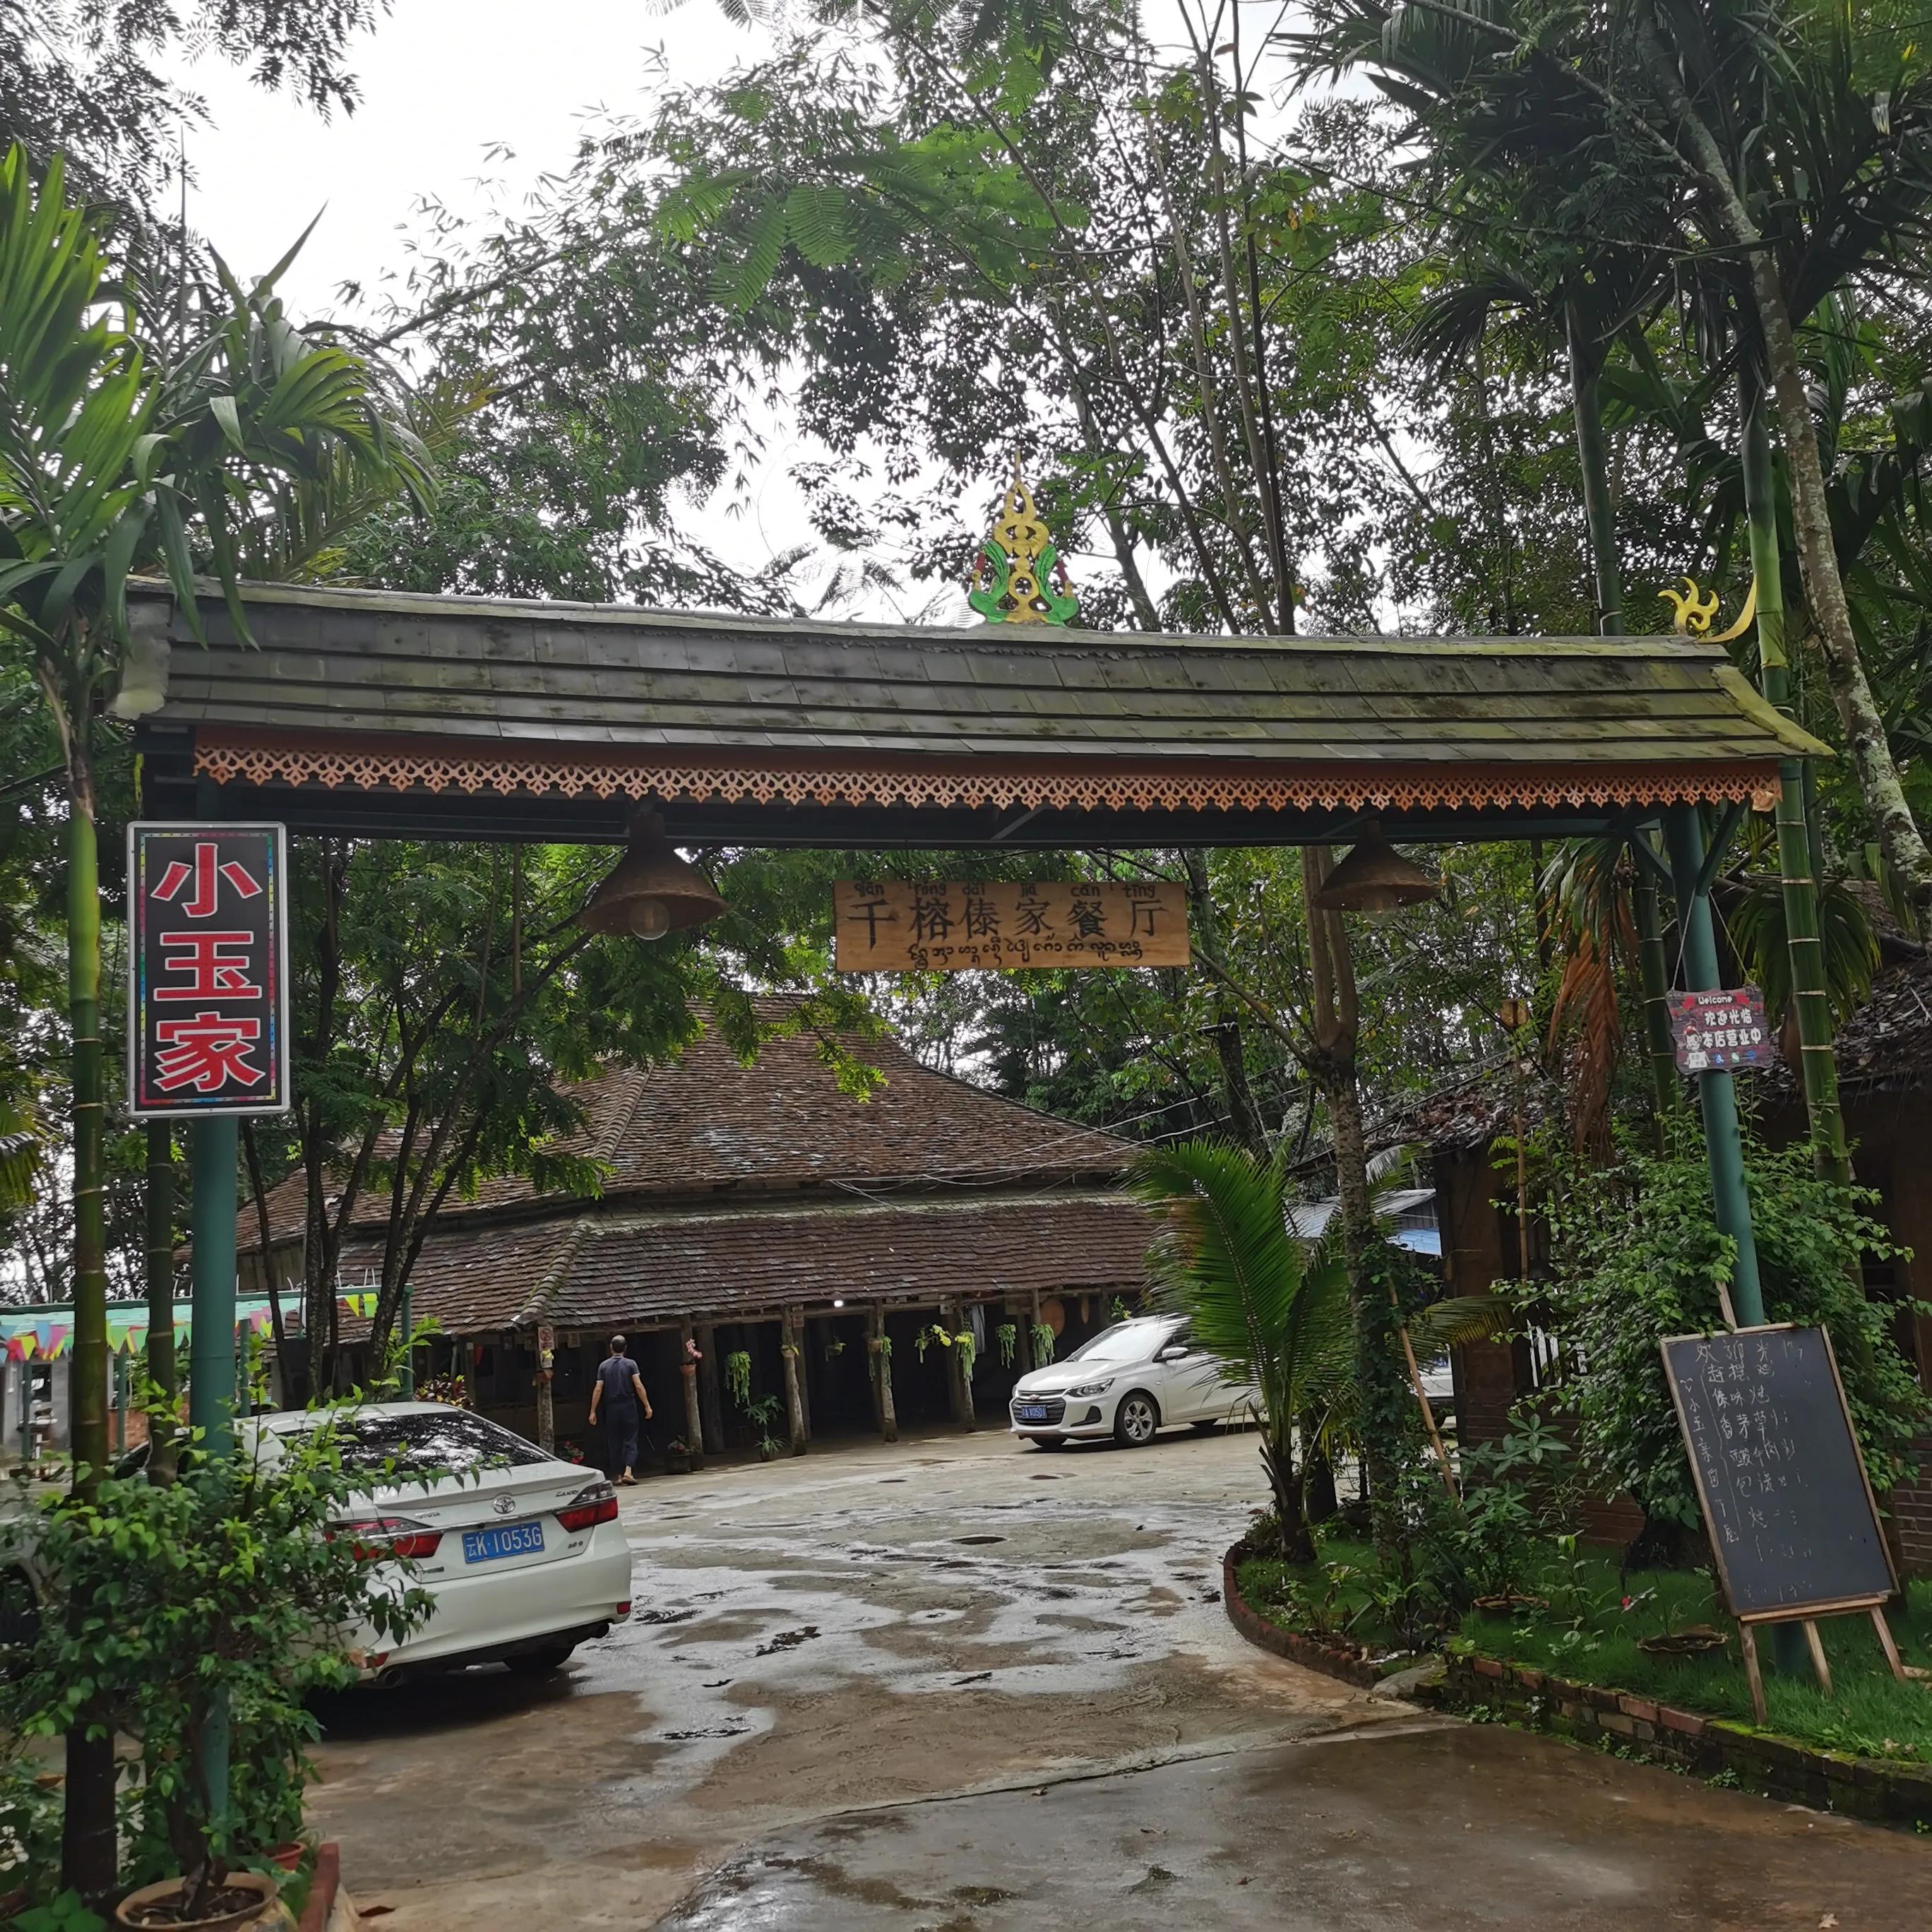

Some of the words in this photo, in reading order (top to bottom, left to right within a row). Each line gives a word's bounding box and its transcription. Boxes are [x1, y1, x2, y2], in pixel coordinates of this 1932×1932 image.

[847, 897, 1169, 951] 千榕傣家餐厅
[150, 842, 266, 1092] 小玉家
[1698, 996, 1733, 1006] Welcome
[1704, 1008, 1753, 1027] 欢迎光临
[1702, 1027, 1762, 1049] 本店营业中
